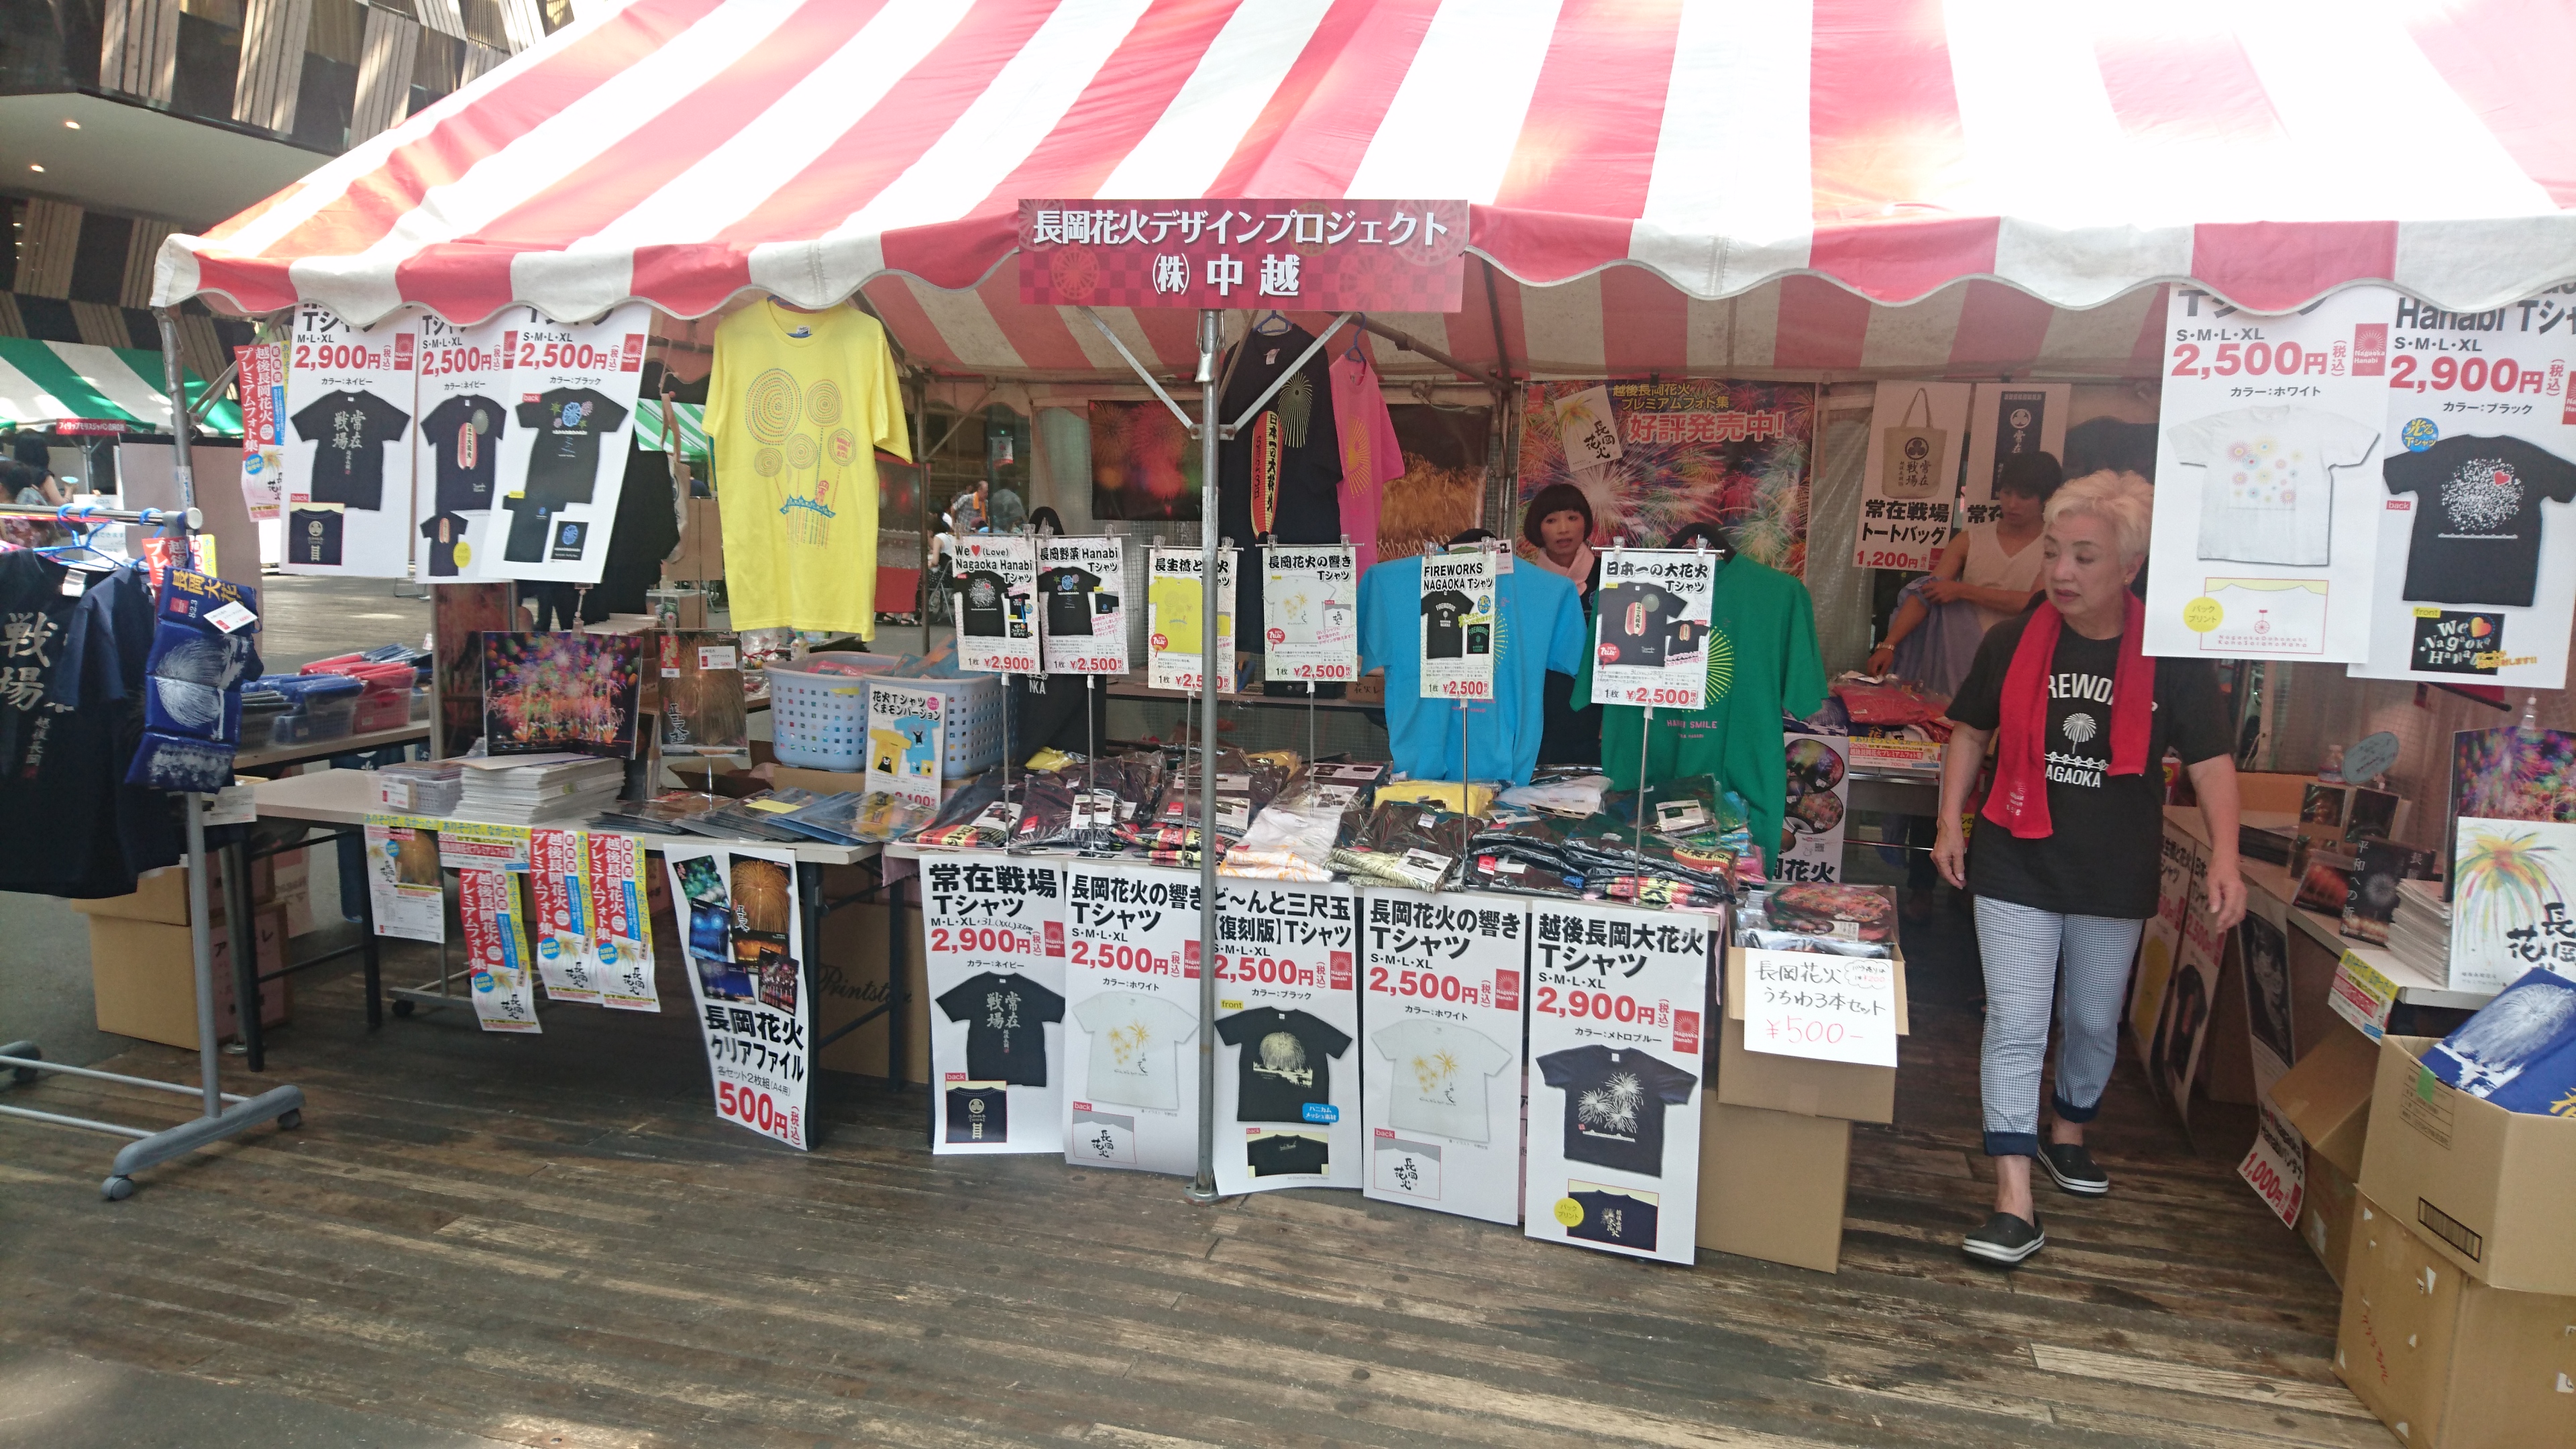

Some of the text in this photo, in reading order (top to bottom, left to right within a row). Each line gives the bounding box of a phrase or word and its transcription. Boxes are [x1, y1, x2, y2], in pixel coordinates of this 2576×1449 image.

[1033, 209, 1447, 246] 長岡花火デザインプロジェクト
[294, 345, 380, 371] 2,900円
[422, 347, 491, 377] 2,500円
[519, 342, 607, 370] 2,500円
[2171, 341, 2328, 380] 2,500円
[256, 347, 274, 423] 越後長岡花火
[2390, 354, 2544, 394] 2,900円
[237, 348, 259, 452] プレミアムフォト集
[1613, 384, 1690, 396] 越後長岡花火
[1622, 395, 1729, 410] プレミアムフォト集
[333, 411, 349, 449] 戦場
[348, 410, 366, 448] 常在
[1628, 411, 1785, 443] 好評発売中!
[2406, 419, 2434, 436] 光る
[2405, 436, 2436, 447] Tシャツ
[1866, 499, 1949, 523] 常在戦場
[2388, 502, 2409, 510] back
[1862, 523, 1947, 545] トートバッグ
[955, 545, 969, 555] We
[1082, 547, 1118, 558] Hanabi
[1269, 555, 1351, 568] 長岡花火の響き
[1857, 550, 1918, 569] 1,200円
[956, 559, 1032, 572] Nagaoka Hanabi
[1087, 563, 1118, 572] Tシャツ
[1317, 570, 1349, 581] Tシャツ
[1424, 563, 1483, 577] FIREWORKS
[1606, 561, 1708, 578] 日本一の大花火
[1004, 573, 1032, 584] Tシャツ
[1424, 578, 1493, 590] NAGAOKA Tシャツ
[1665, 581, 1705, 592] Tシャツ
[2188, 615, 2217, 623] プリント
[2192, 605, 2215, 613] バック
[2416, 608, 2438, 616] front
[969, 657, 979, 665] 1枚
[1275, 667, 1287, 676] 1枚
[1159, 676, 1169, 684] 1枚
[1429, 684, 1438, 692] 1枚
[873, 690, 926, 706] 花火Tシャツ
[1605, 689, 1619, 698] 1枚
[873, 705, 941, 721] くまモンバージョン
[1690, 720, 1717, 729] SMILE
[547, 832, 568, 908] 越後長岡花火
[605, 837, 625, 914] 越後長岡花火
[929, 863, 1057, 898] 常在戦場
[532, 833, 554, 935] プレミアムフォト集
[589, 837, 611, 940] プレミアムフォト集
[476, 872, 500, 945] 越後長岡花火
[932, 895, 1024, 918] Tシャツ
[1071, 902, 1161, 932] Tシャツ
[462, 872, 487, 971] プレミアムフォト集
[1371, 898, 1521, 939] 長岡花火の響き
[931, 928, 1030, 954] 2,900円
[1370, 926, 1470, 959] Tシャツ
[1538, 913, 1705, 957] 越後長岡大花火
[1071, 941, 1169, 975] 2,500円
[1538, 943, 1648, 978] Tシャツ
[1215, 954, 1313, 986] 2,500円
[1755, 961, 1841, 984] 長岡花火
[1369, 967, 1478, 1004] 2,500円
[986, 991, 1004, 1028] 戦場
[1005, 991, 1022, 1028] 常在
[1222, 1000, 1242, 1008] front
[1536, 986, 1655, 1025] 2,900円
[1764, 987, 1886, 1016] うちわ3本セット
[705, 1004, 804, 1051] 長岡花火
[1674, 1030, 1697, 1038] Nagaoka
[712, 1034, 804, 1083] クリアファイル
[947, 1073, 965, 1081] back
[719, 1081, 788, 1138] 500円
[1376, 1130, 1393, 1138] back
